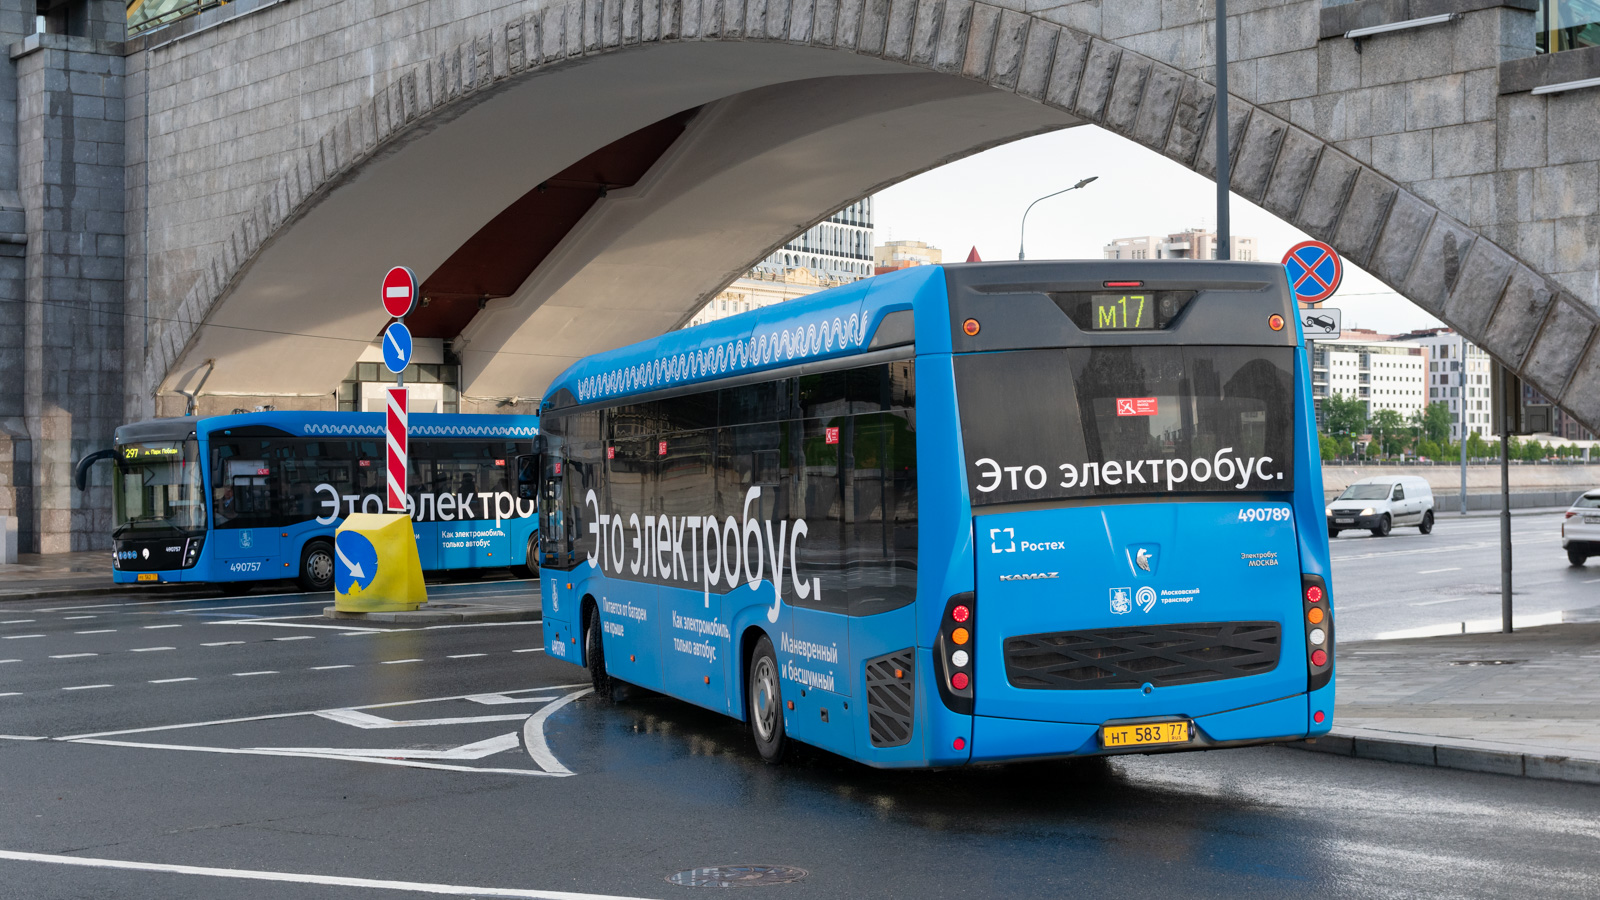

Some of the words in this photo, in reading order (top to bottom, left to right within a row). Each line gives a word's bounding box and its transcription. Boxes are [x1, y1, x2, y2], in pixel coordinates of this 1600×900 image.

[125, 448, 139, 459] 297
[974, 457, 1047, 493] Это
[1059, 447, 1284, 491] электробус.
[314, 483, 384, 526] Это
[405, 491, 539, 528] электро
[1238, 507, 1290, 522] 490789
[441, 530, 454, 538] Как
[454, 529, 506, 539] электромобиль,
[465, 539, 491, 548] автобус
[1020, 540, 1066, 552] Ростех
[585, 488, 625, 575] Это
[629, 485, 821, 624] электробус.
[1240, 551, 1278, 560] Электробус
[230, 562, 262, 572] 490757
[1248, 559, 1279, 567] МОСКВА
[999, 571, 1060, 582] KAMAZ
[1160, 587, 1200, 596] Московский
[1160, 596, 1194, 605] транспорт
[602, 597, 621, 615] Питается
[622, 605, 627, 616] от
[627, 601, 647, 623] батареи
[603, 621, 610, 632] на
[672, 610, 684, 629] Как
[683, 616, 731, 643] электромобиль,
[673, 637, 692, 655] только
[692, 639, 717, 664] автобус
[780, 631, 838, 665] Маневренный
[781, 663, 788, 680] и
[787, 659, 835, 692] бесшумный
[1111, 731, 1128, 744] НТ
[1135, 726, 1162, 742] 583
[1169, 723, 1183, 736] 77
